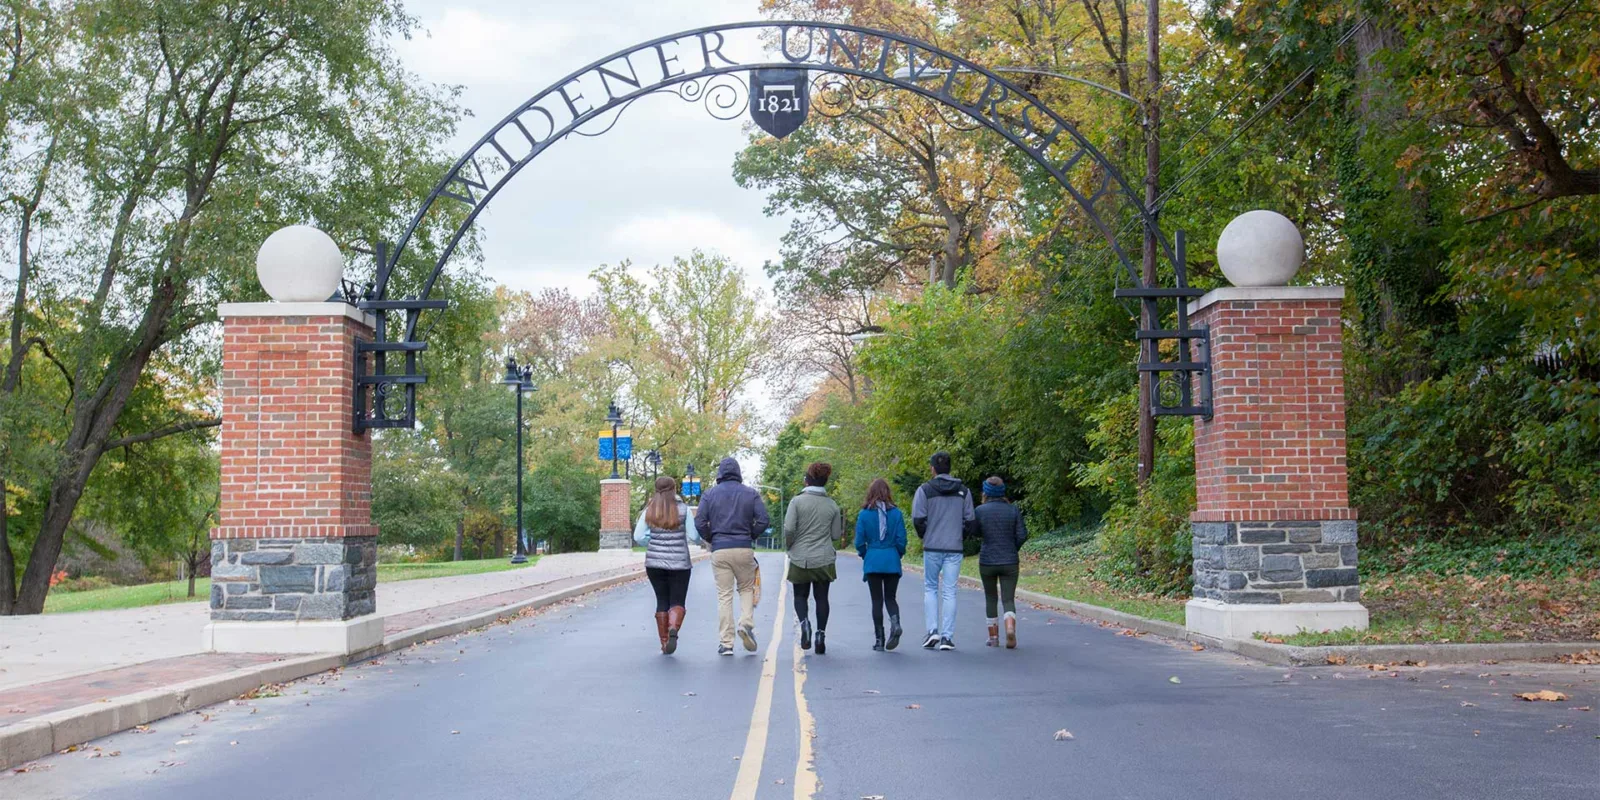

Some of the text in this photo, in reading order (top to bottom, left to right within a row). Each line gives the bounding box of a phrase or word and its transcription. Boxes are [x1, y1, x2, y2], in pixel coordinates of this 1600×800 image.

[438, 25, 1128, 206] WIDENER UNIVERSITY
[758, 95, 801, 113] 1821
